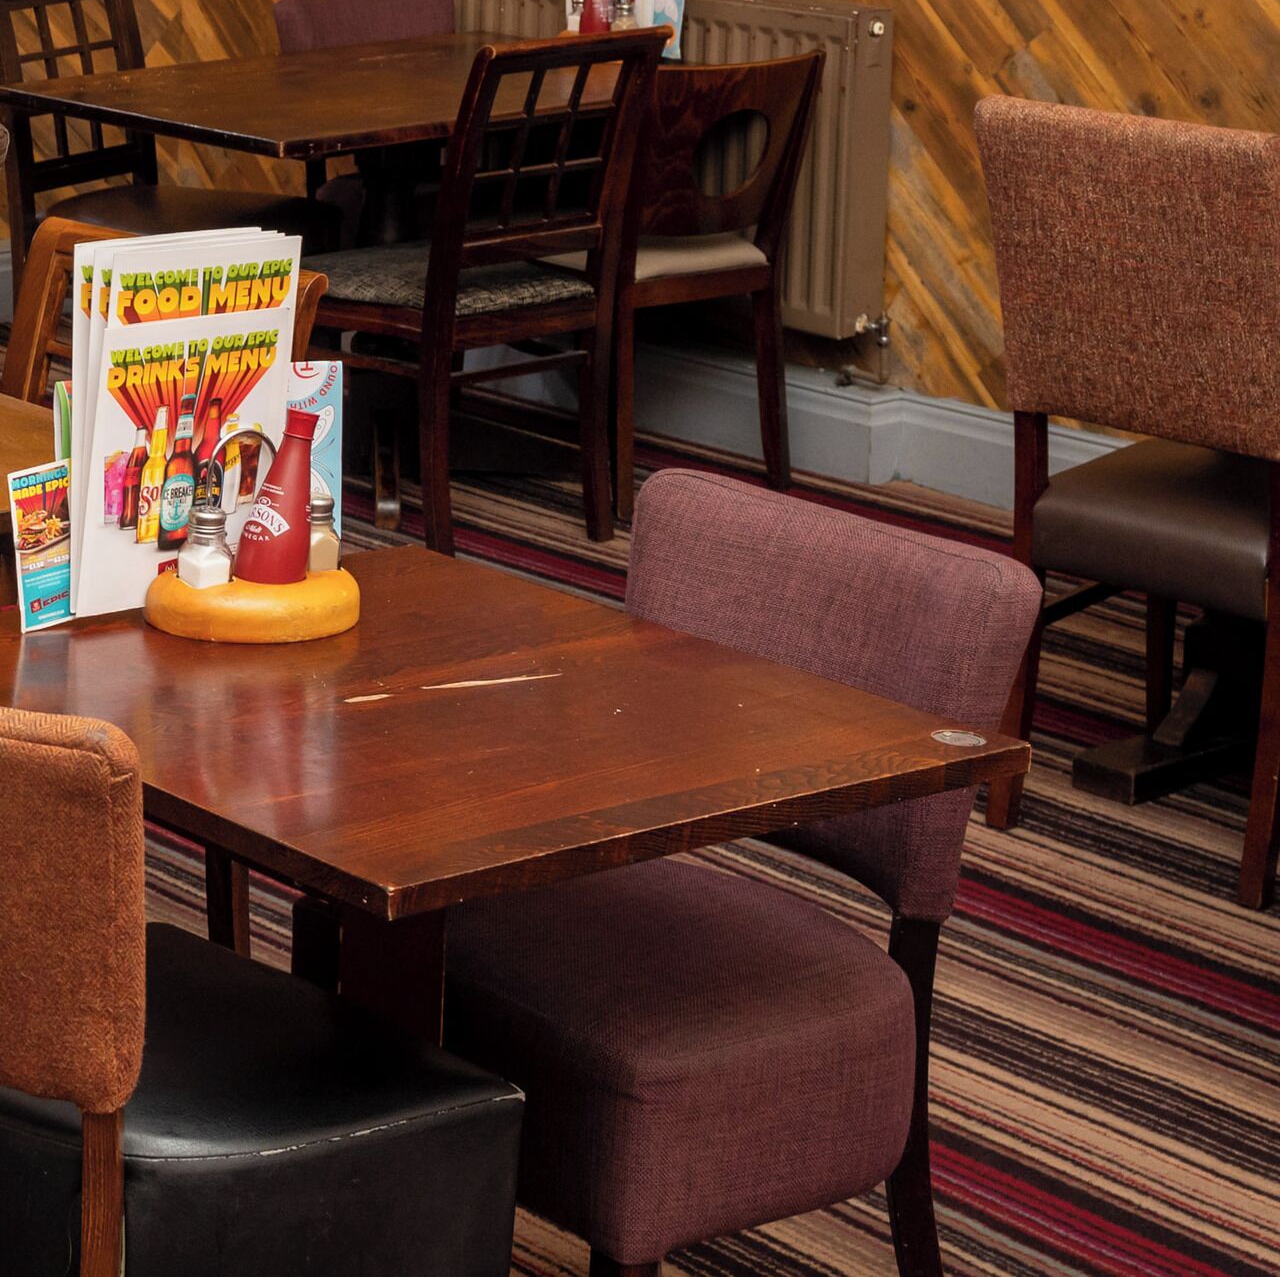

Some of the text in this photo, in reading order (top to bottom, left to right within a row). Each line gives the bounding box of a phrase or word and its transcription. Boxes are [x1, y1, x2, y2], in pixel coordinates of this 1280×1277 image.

[120, 258, 293, 288] WELCOME TO OUR EPIC
[117, 275, 290, 317] FOOD MENU
[110, 329, 279, 364] WELCOME TO OUR EPIC
[107, 346, 277, 389] DRINKS MENU
[11, 466, 68, 490] MORNINGS
[12, 478, 69, 500] MADE EPIC
[248, 504, 285, 533] RSON'S
[43, 591, 69, 607] EPIC
